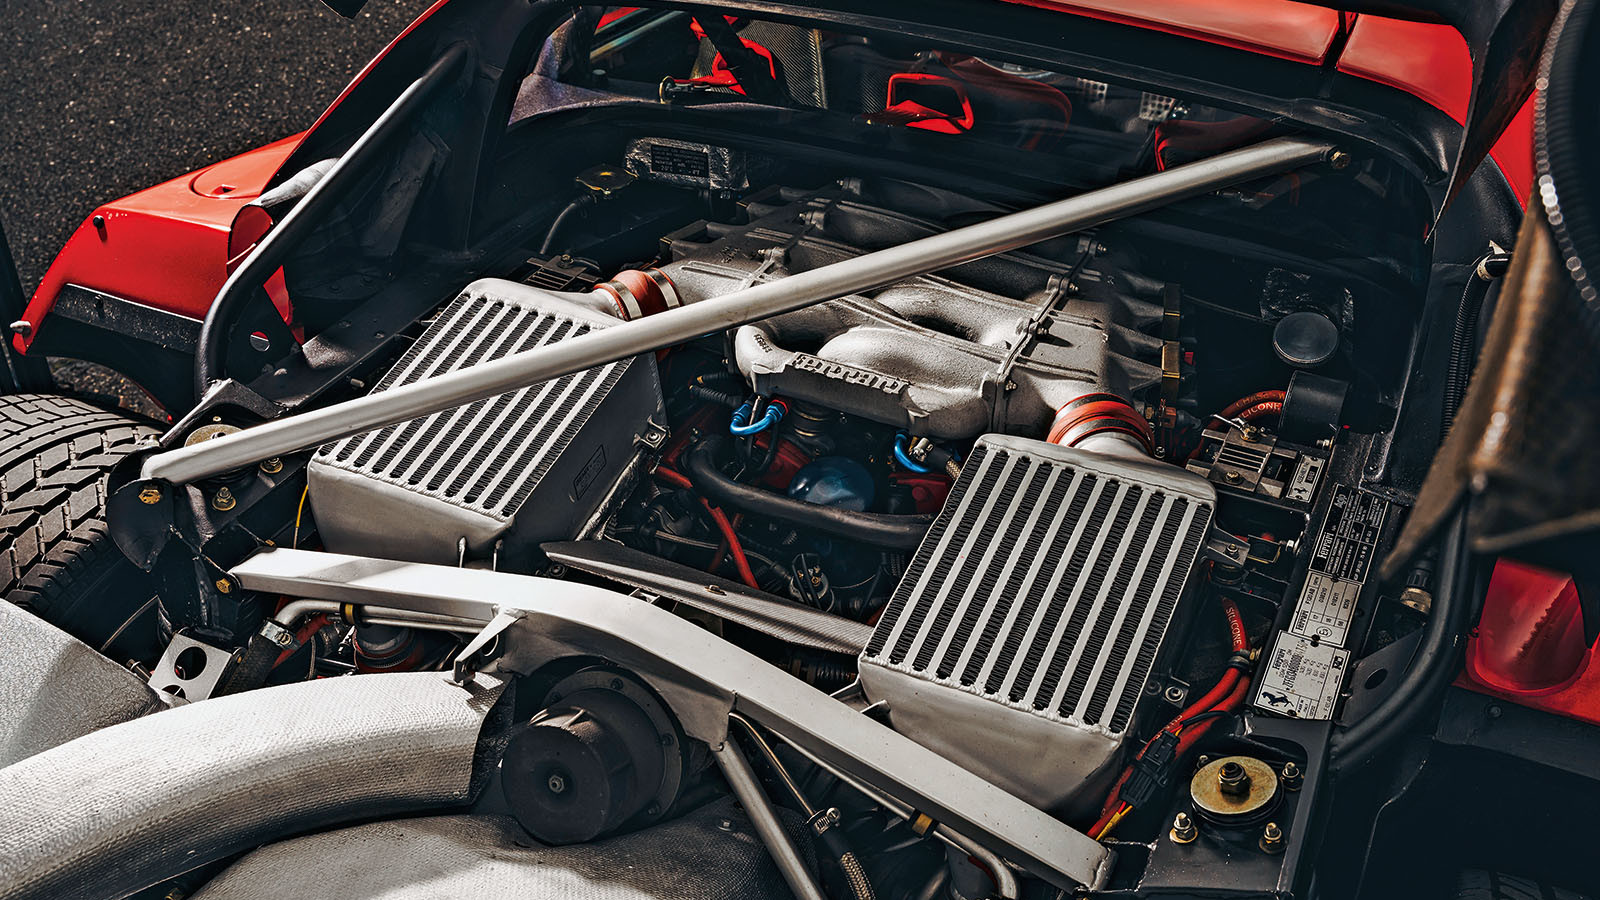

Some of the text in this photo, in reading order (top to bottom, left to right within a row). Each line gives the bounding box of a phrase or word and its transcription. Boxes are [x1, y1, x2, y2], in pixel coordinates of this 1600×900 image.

[794, 352, 909, 395] Ferrari
[1317, 531, 1334, 559] Ferrari
[1334, 492, 1349, 509] Agip
[1225, 606, 1242, 647] SILICONE
[1295, 610, 1309, 631] Ferrari
[1272, 648, 1286, 670] Ferrari
